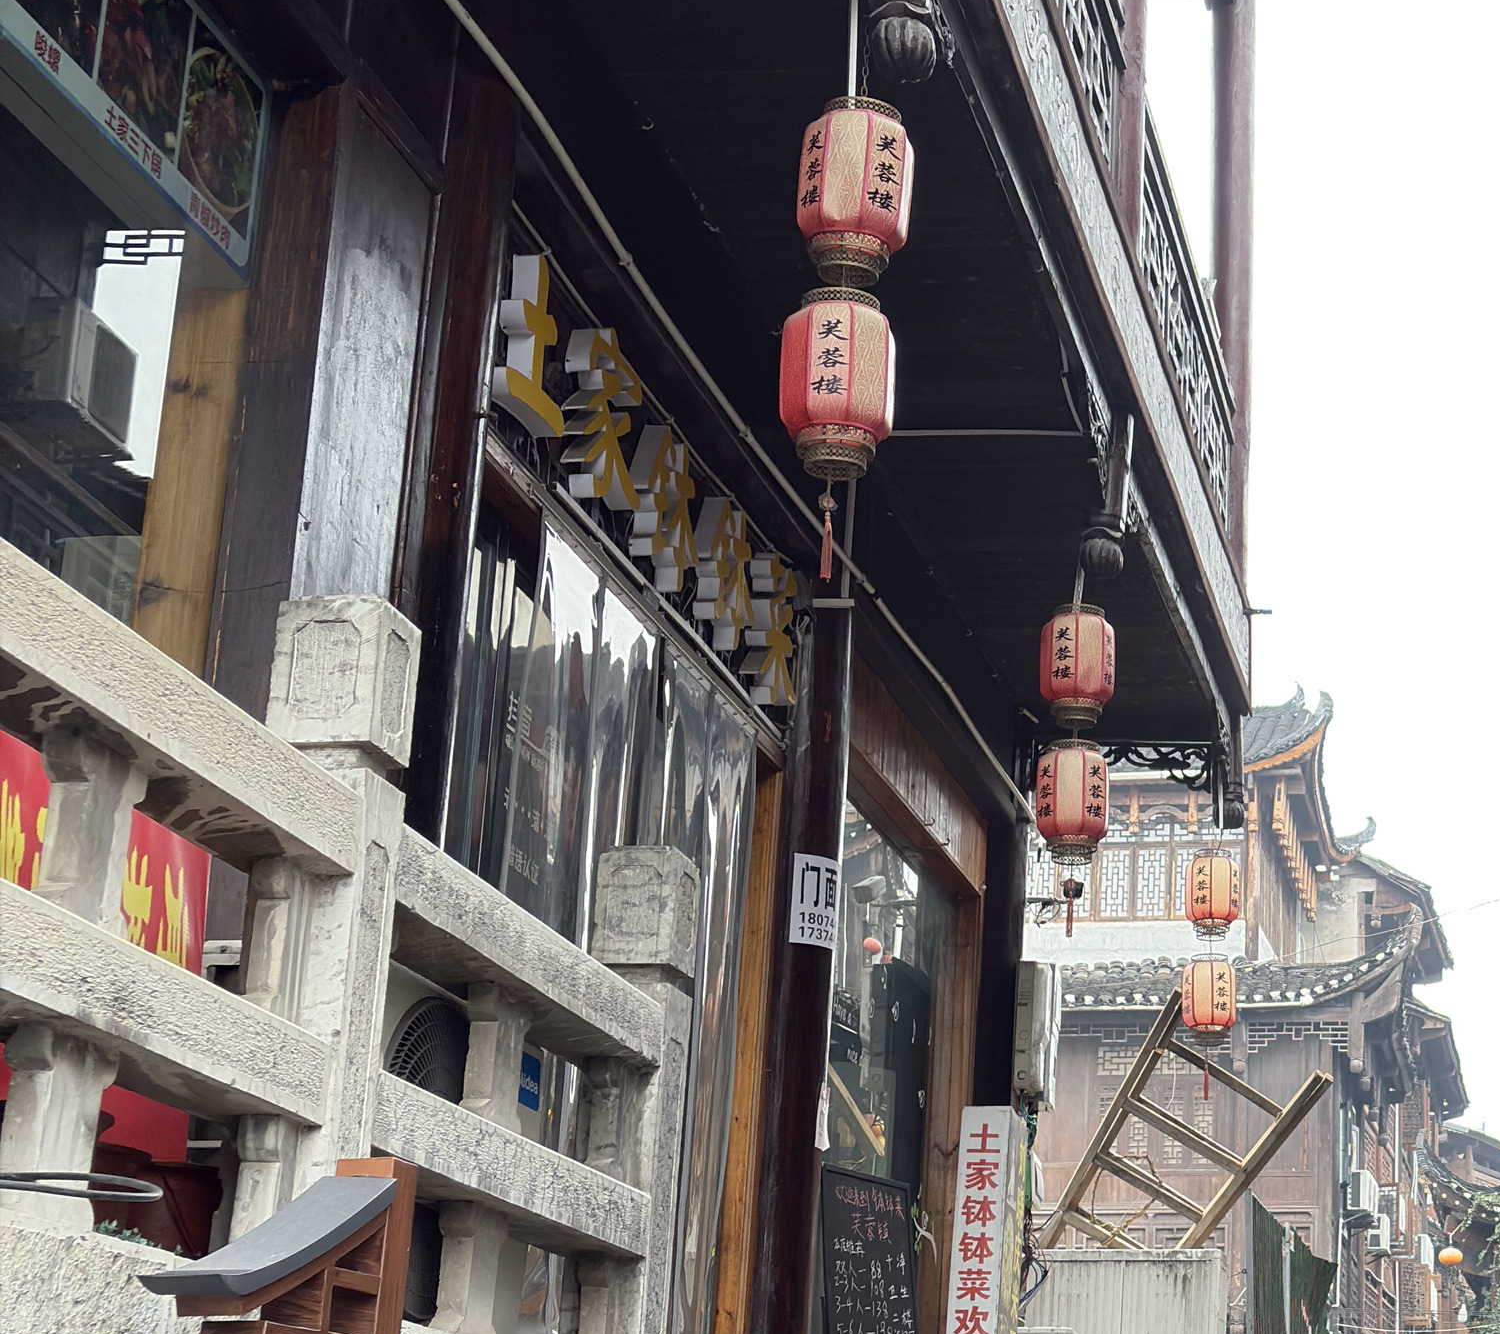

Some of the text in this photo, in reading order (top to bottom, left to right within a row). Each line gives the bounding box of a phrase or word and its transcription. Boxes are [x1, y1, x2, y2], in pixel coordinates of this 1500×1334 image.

[801, 130, 825, 208] 芙蓉楼
[867, 134, 902, 213] 芙蓉楼
[810, 319, 849, 396] 芙蓉楼
[1052, 626, 1075, 680] 芙蓉楼
[1037, 764, 1054, 819] 芙蓉楼
[1086, 764, 1105, 820] 芙蓉楼
[800, 862, 838, 912] 门面
[1193, 865, 1210, 906] 芙蓉楼
[1213, 972, 1231, 1012] 芙蓉楼
[521, 1072, 539, 1095] idea
